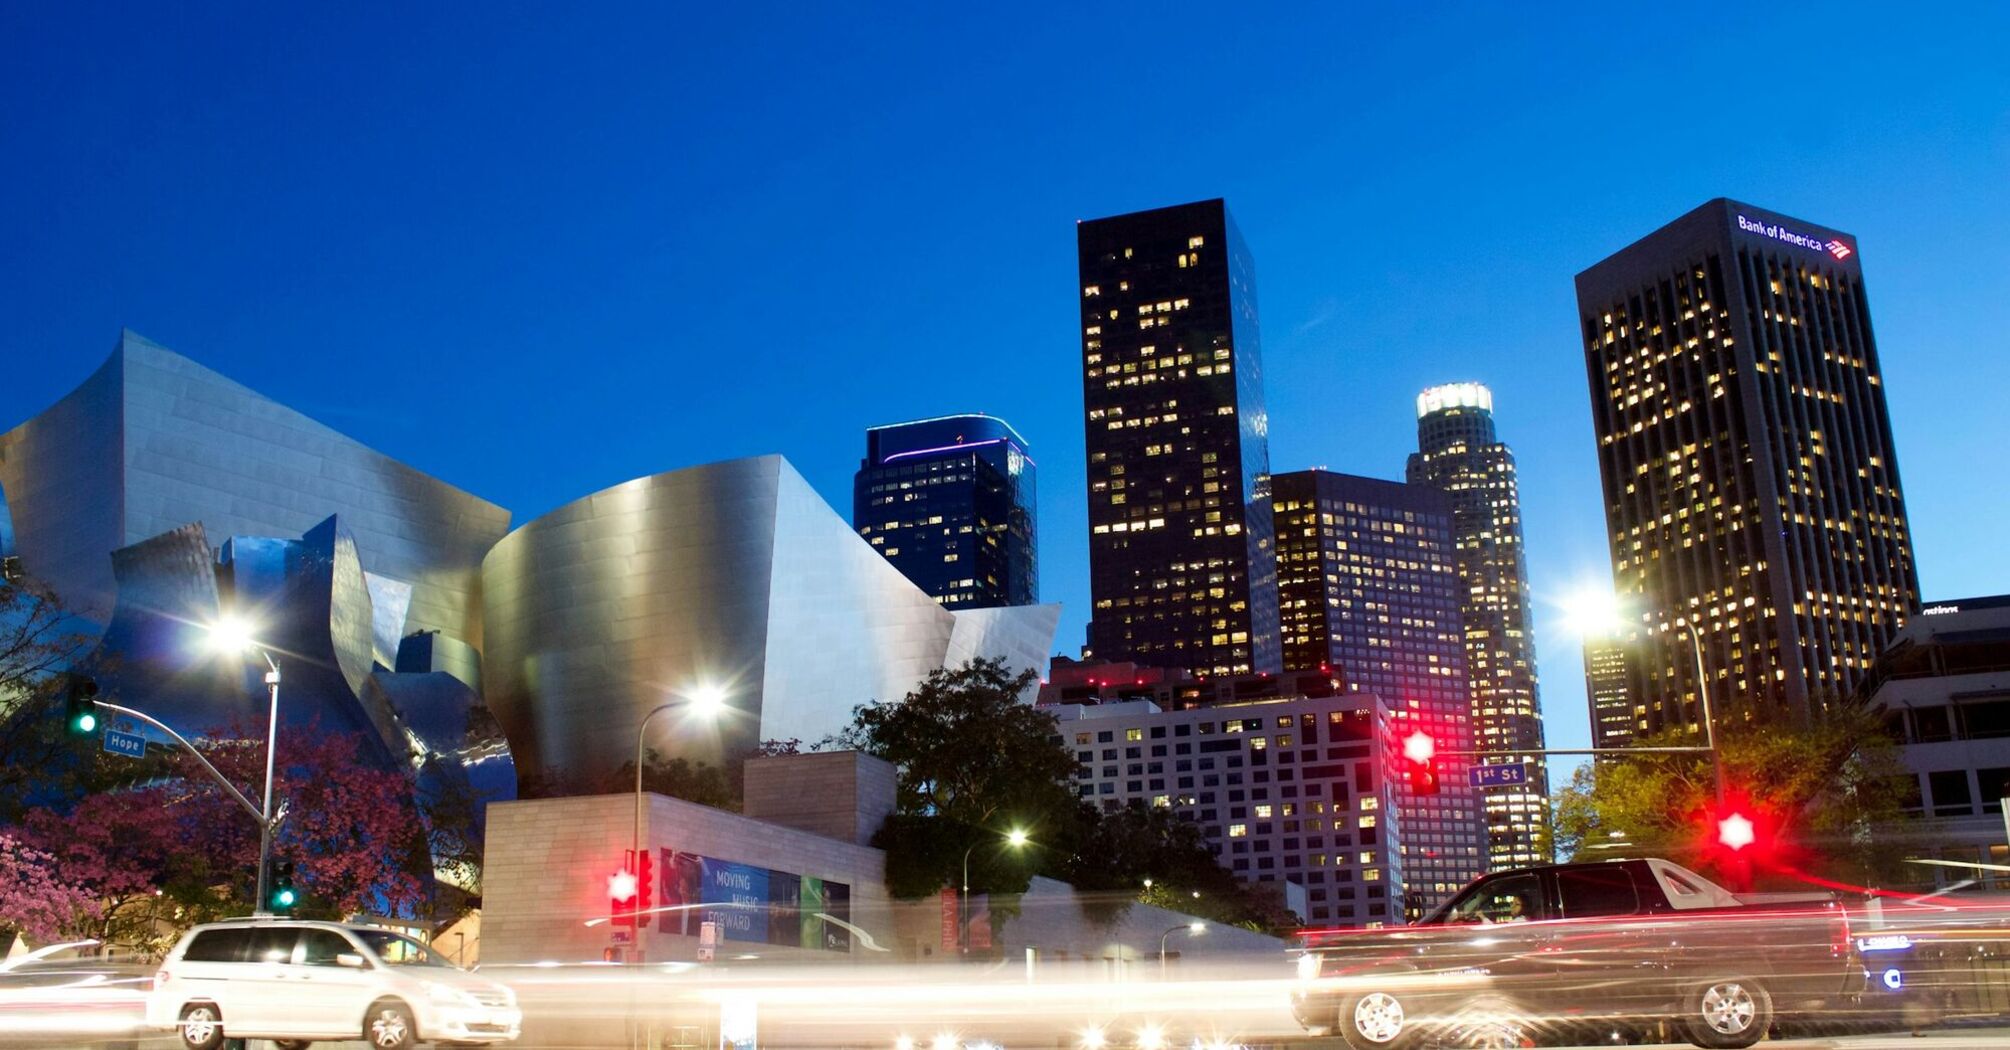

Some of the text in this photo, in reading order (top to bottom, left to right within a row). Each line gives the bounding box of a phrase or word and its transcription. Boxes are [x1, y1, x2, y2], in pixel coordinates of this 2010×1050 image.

[1737, 214, 1823, 251] Bank of America
[111, 734, 139, 751] Hope
[1476, 768, 1518, 783] 1st St
[716, 869, 751, 890] MOVING
[732, 893, 759, 913] MUSIC
[708, 910, 751, 931] FORWARD
